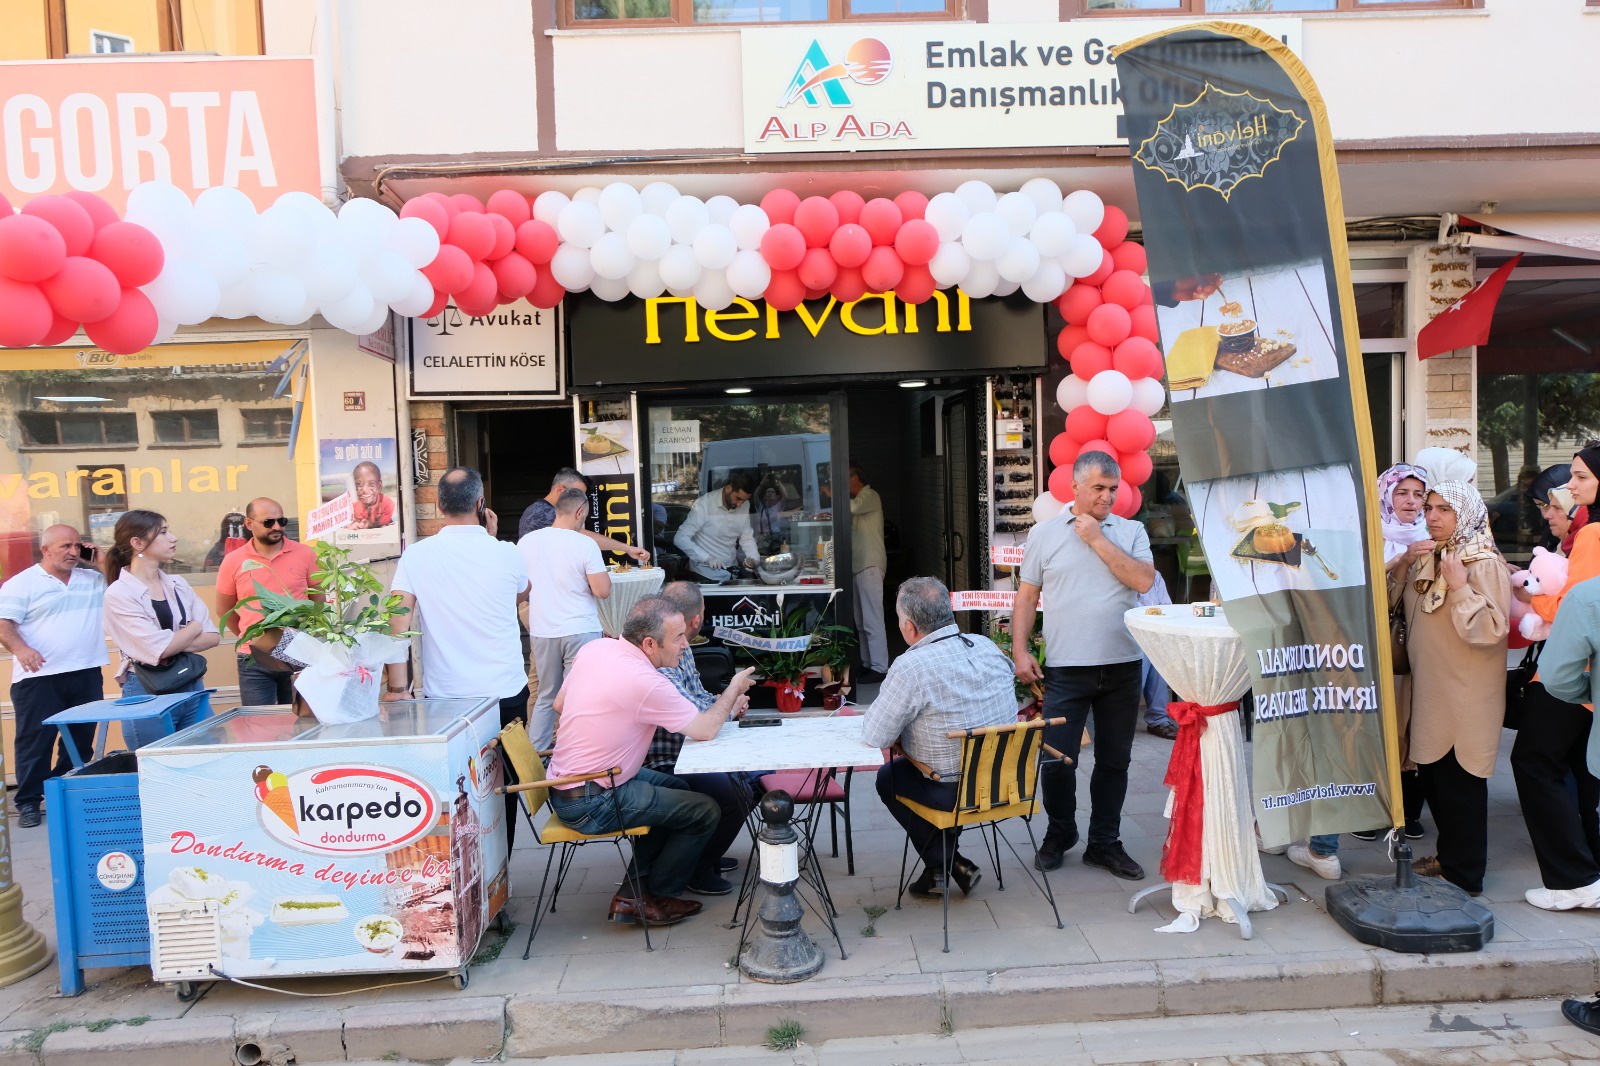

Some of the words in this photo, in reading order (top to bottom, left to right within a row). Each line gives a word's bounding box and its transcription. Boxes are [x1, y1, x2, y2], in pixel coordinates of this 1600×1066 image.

[926, 40, 1028, 68] Emlak
[1037, 45, 1073, 66] ve
[927, 78, 1123, 115] Danışmanlık
[759, 116, 827, 140] ALP
[835, 114, 913, 139] ADA
[3, 90, 279, 194] GORTA
[469, 310, 542, 326] Avukat
[423, 353, 506, 368] CELALETTİN
[510, 352, 546, 367] KÖSE
[662, 426, 692, 434] ELEMAN
[346, 443, 359, 461] gibi
[360, 443, 373, 459] aziz
[1015, 547, 1025, 556] İŞY
[299, 792, 422, 830] karpedo
[320, 831, 386, 844] dondurma
[169, 830, 306, 877] Dondurma
[313, 863, 414, 892] deyince
